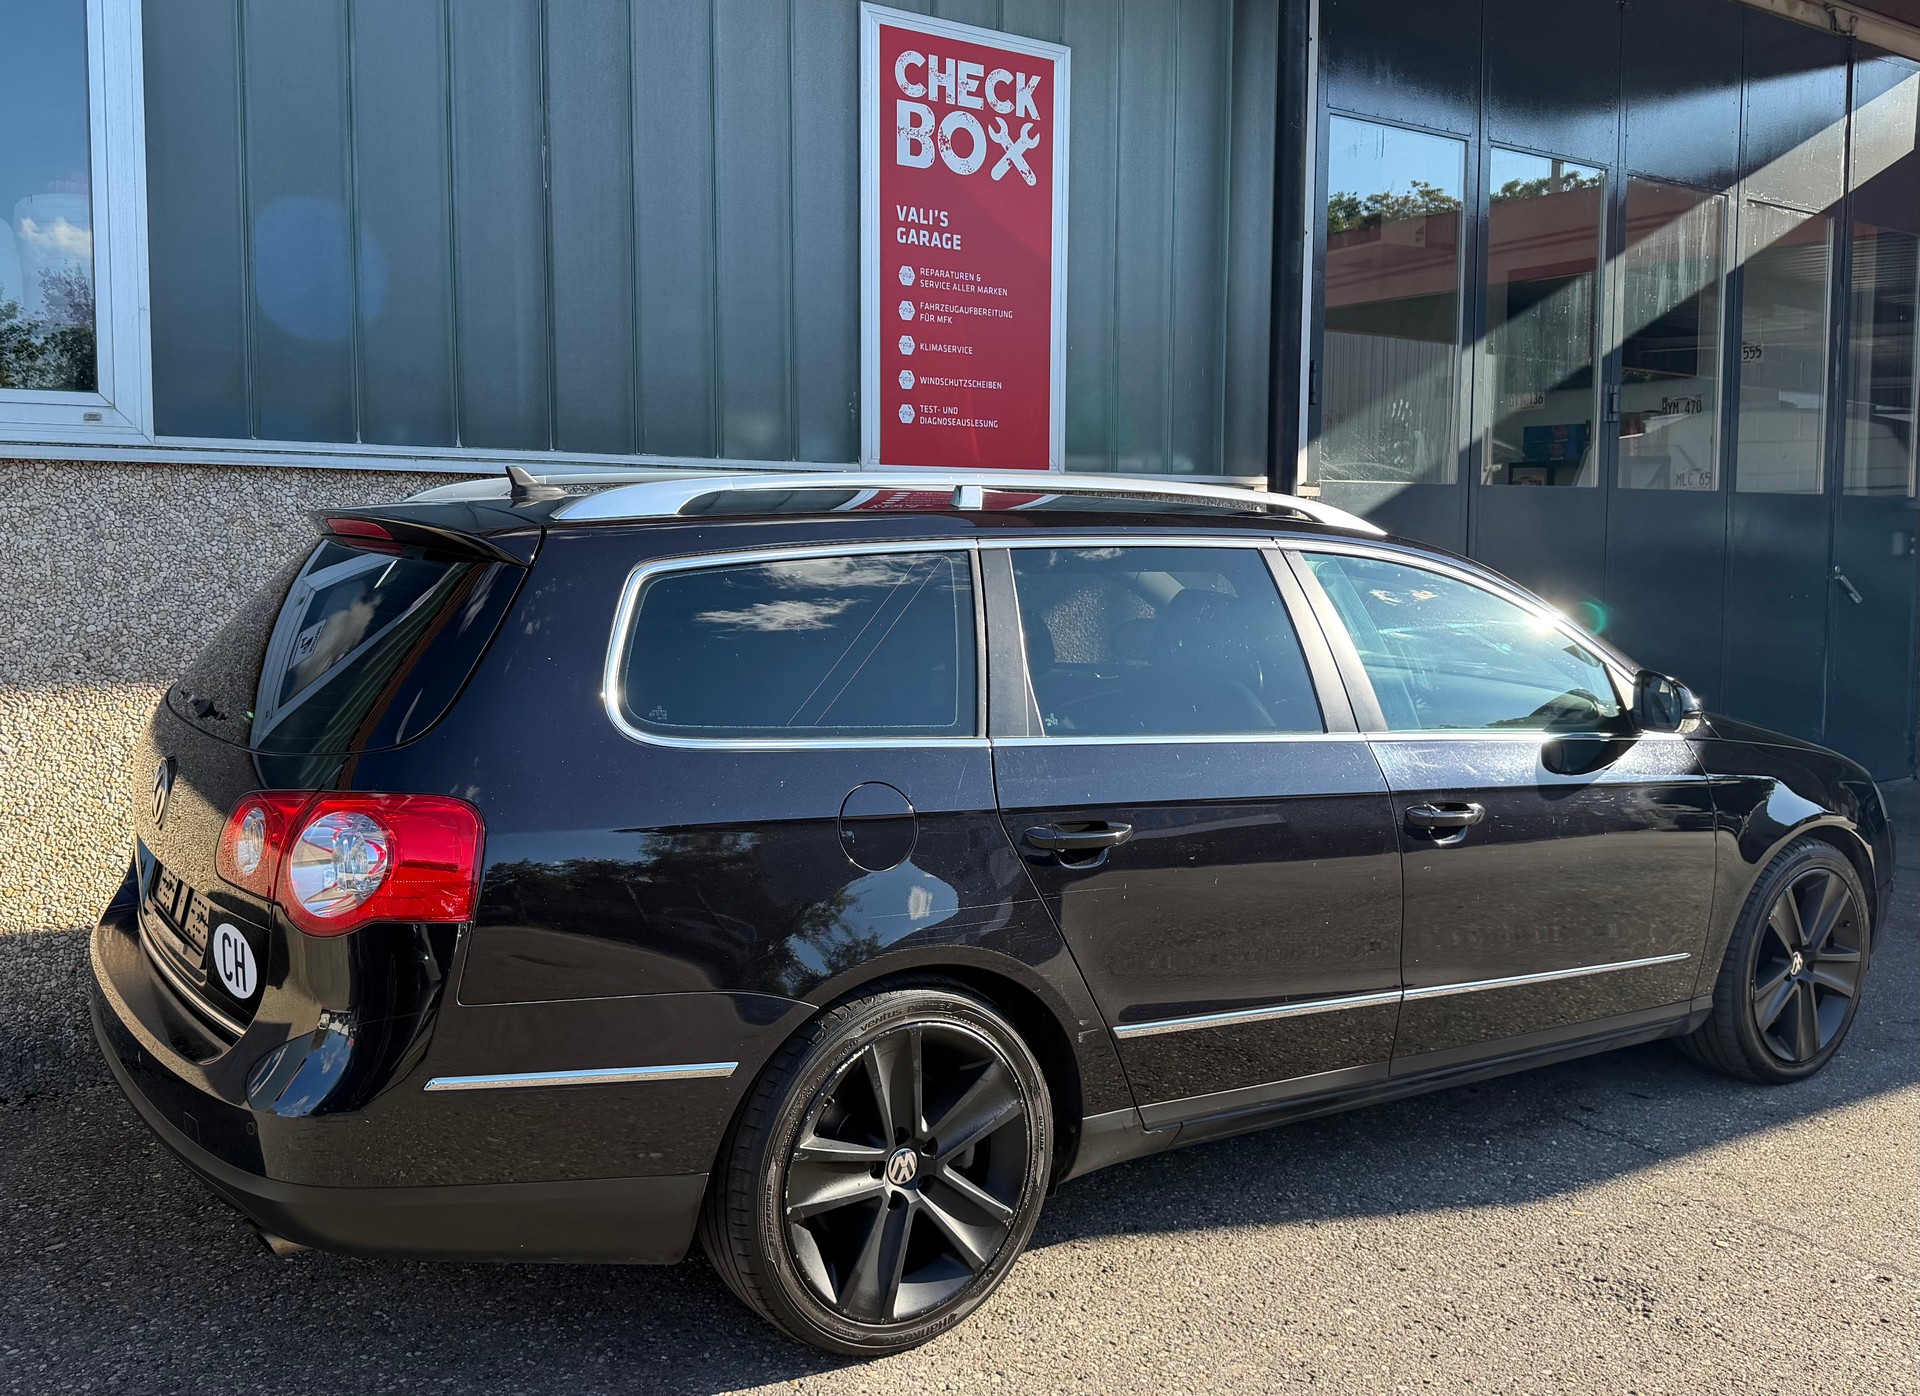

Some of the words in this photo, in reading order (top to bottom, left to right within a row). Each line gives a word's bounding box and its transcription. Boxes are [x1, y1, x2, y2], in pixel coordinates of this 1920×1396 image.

[894, 50, 1042, 121] CHECK
[896, 204, 949, 227] VALI'S
[896, 227, 962, 250] GARAGE
[920, 267, 975, 281] REPARATUREN
[976, 273, 982, 282] &
[920, 279, 951, 291] SERVICE
[952, 283, 976, 293] ALLER
[977, 286, 1008, 297] MARKEN
[920, 301, 1013, 319] FAHRZEUGAUFBEREITUNG
[920, 312, 935, 323] FÜR
[936, 316, 953, 325] MFK
[920, 342, 973, 355] KLIMASERVICE
[1742, 344, 1762, 360] 555
[920, 376, 1002, 390] WINDSCHUTZSCHEIBEN
[920, 404, 941, 414] TEST-
[942, 406, 959, 415] UND
[1684, 399, 1702, 414] 470
[920, 416, 999, 429] DIAGNOSEAUSLESUNG
[1675, 472, 1694, 487] MLC
[221, 931, 248, 993] CH
